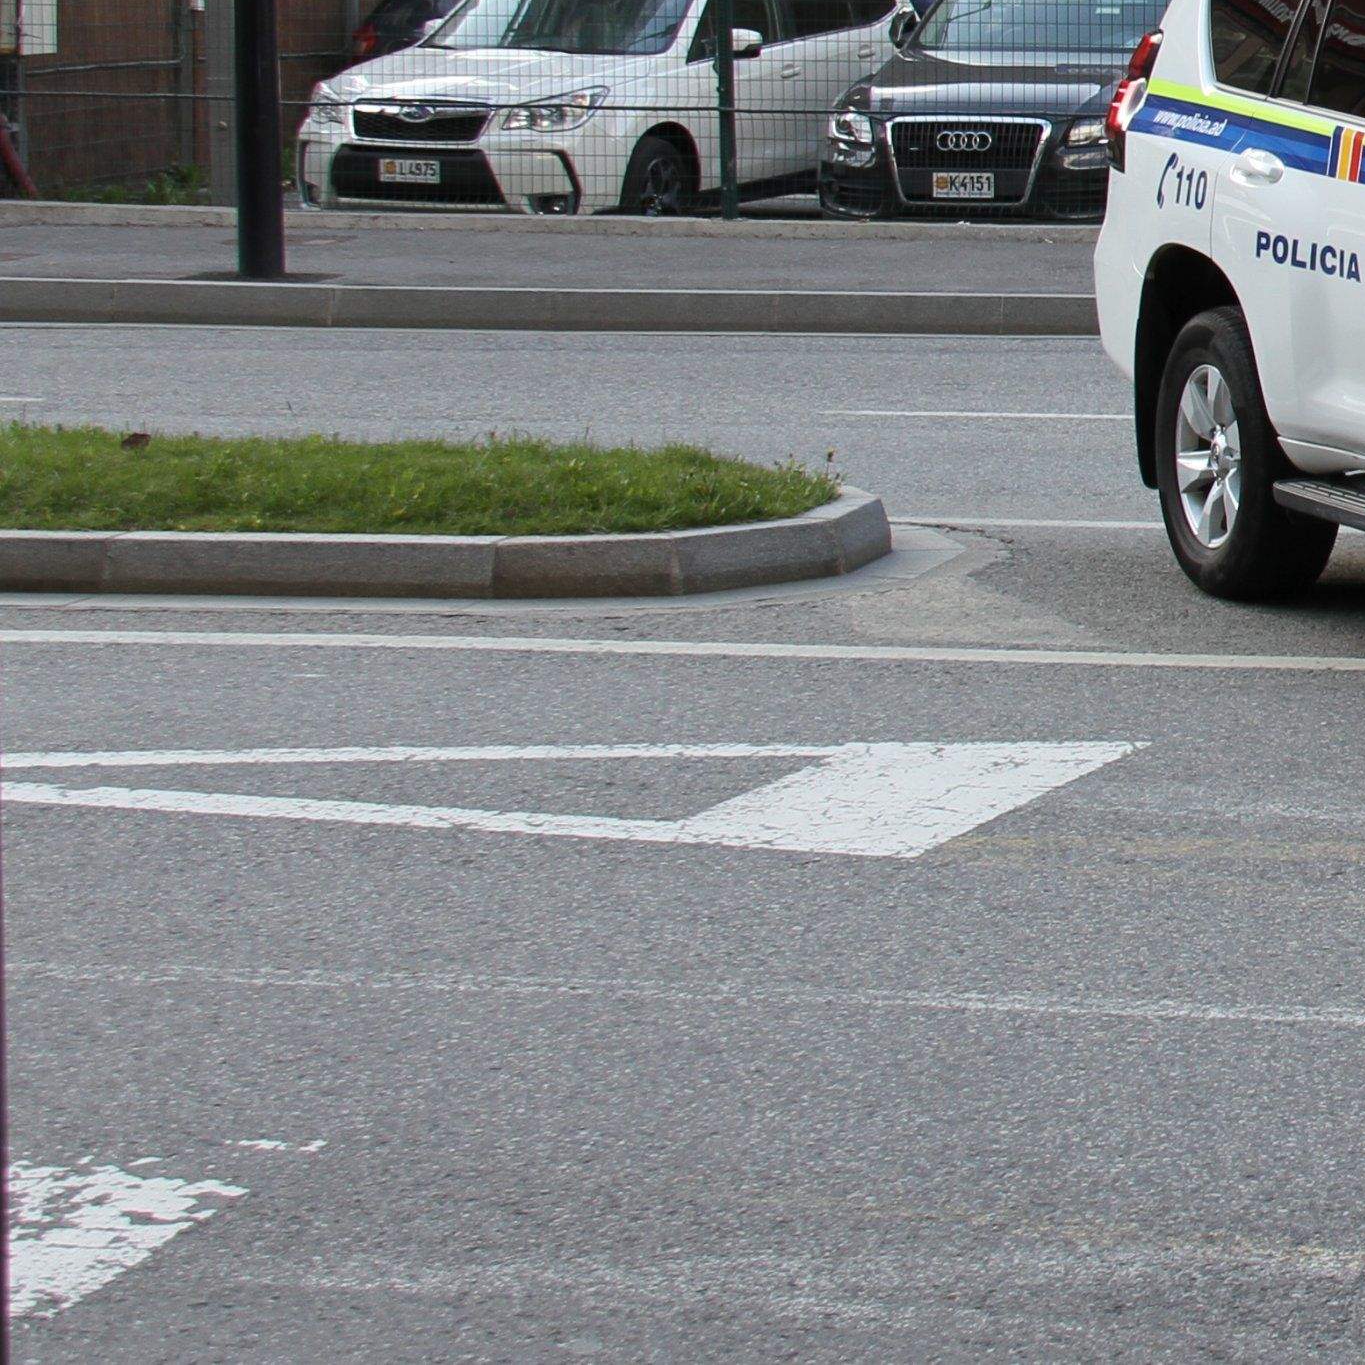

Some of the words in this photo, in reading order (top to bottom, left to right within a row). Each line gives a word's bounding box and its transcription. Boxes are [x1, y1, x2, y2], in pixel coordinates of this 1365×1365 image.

[1153, 109, 1229, 137] www.policia.ad
[1175, 165, 1208, 211] 110
[1255, 229, 1362, 283] POLICIA
